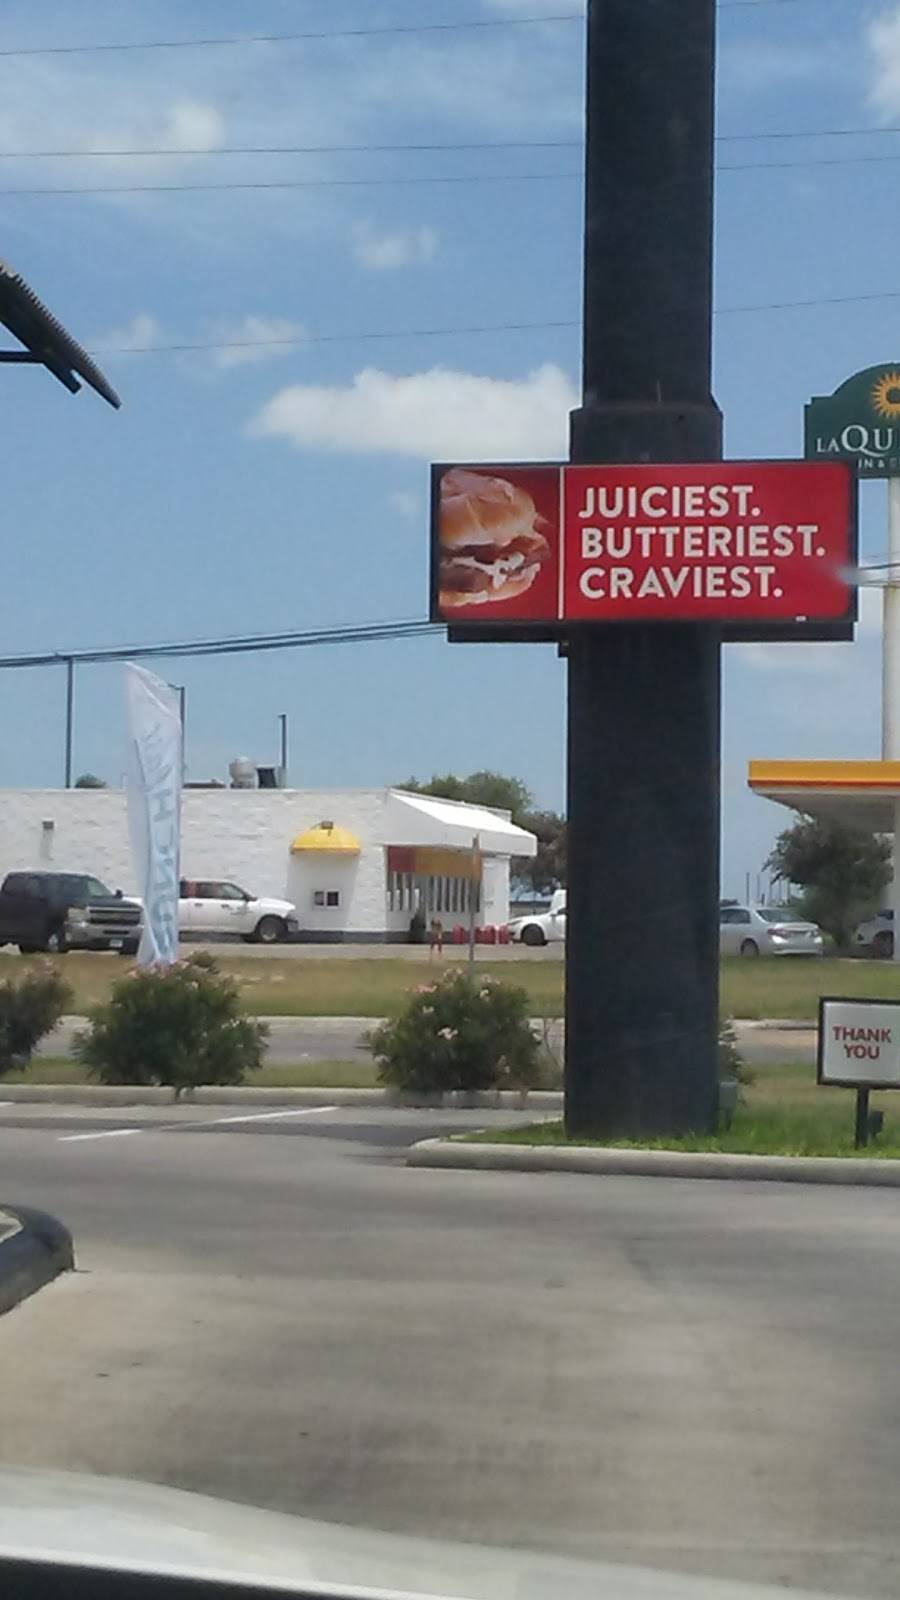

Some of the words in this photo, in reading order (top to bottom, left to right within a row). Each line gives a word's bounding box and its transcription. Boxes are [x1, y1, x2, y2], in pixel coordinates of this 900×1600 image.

[816, 438, 840, 453] LA
[841, 424, 900, 457] QU
[578, 485, 761, 518] JUICIEST.
[581, 525, 825, 559] BUTTERIEST.
[579, 566, 783, 599] CRAVIEST.
[832, 1026, 892, 1043] THANK
[844, 1044, 880, 1060] YOU
